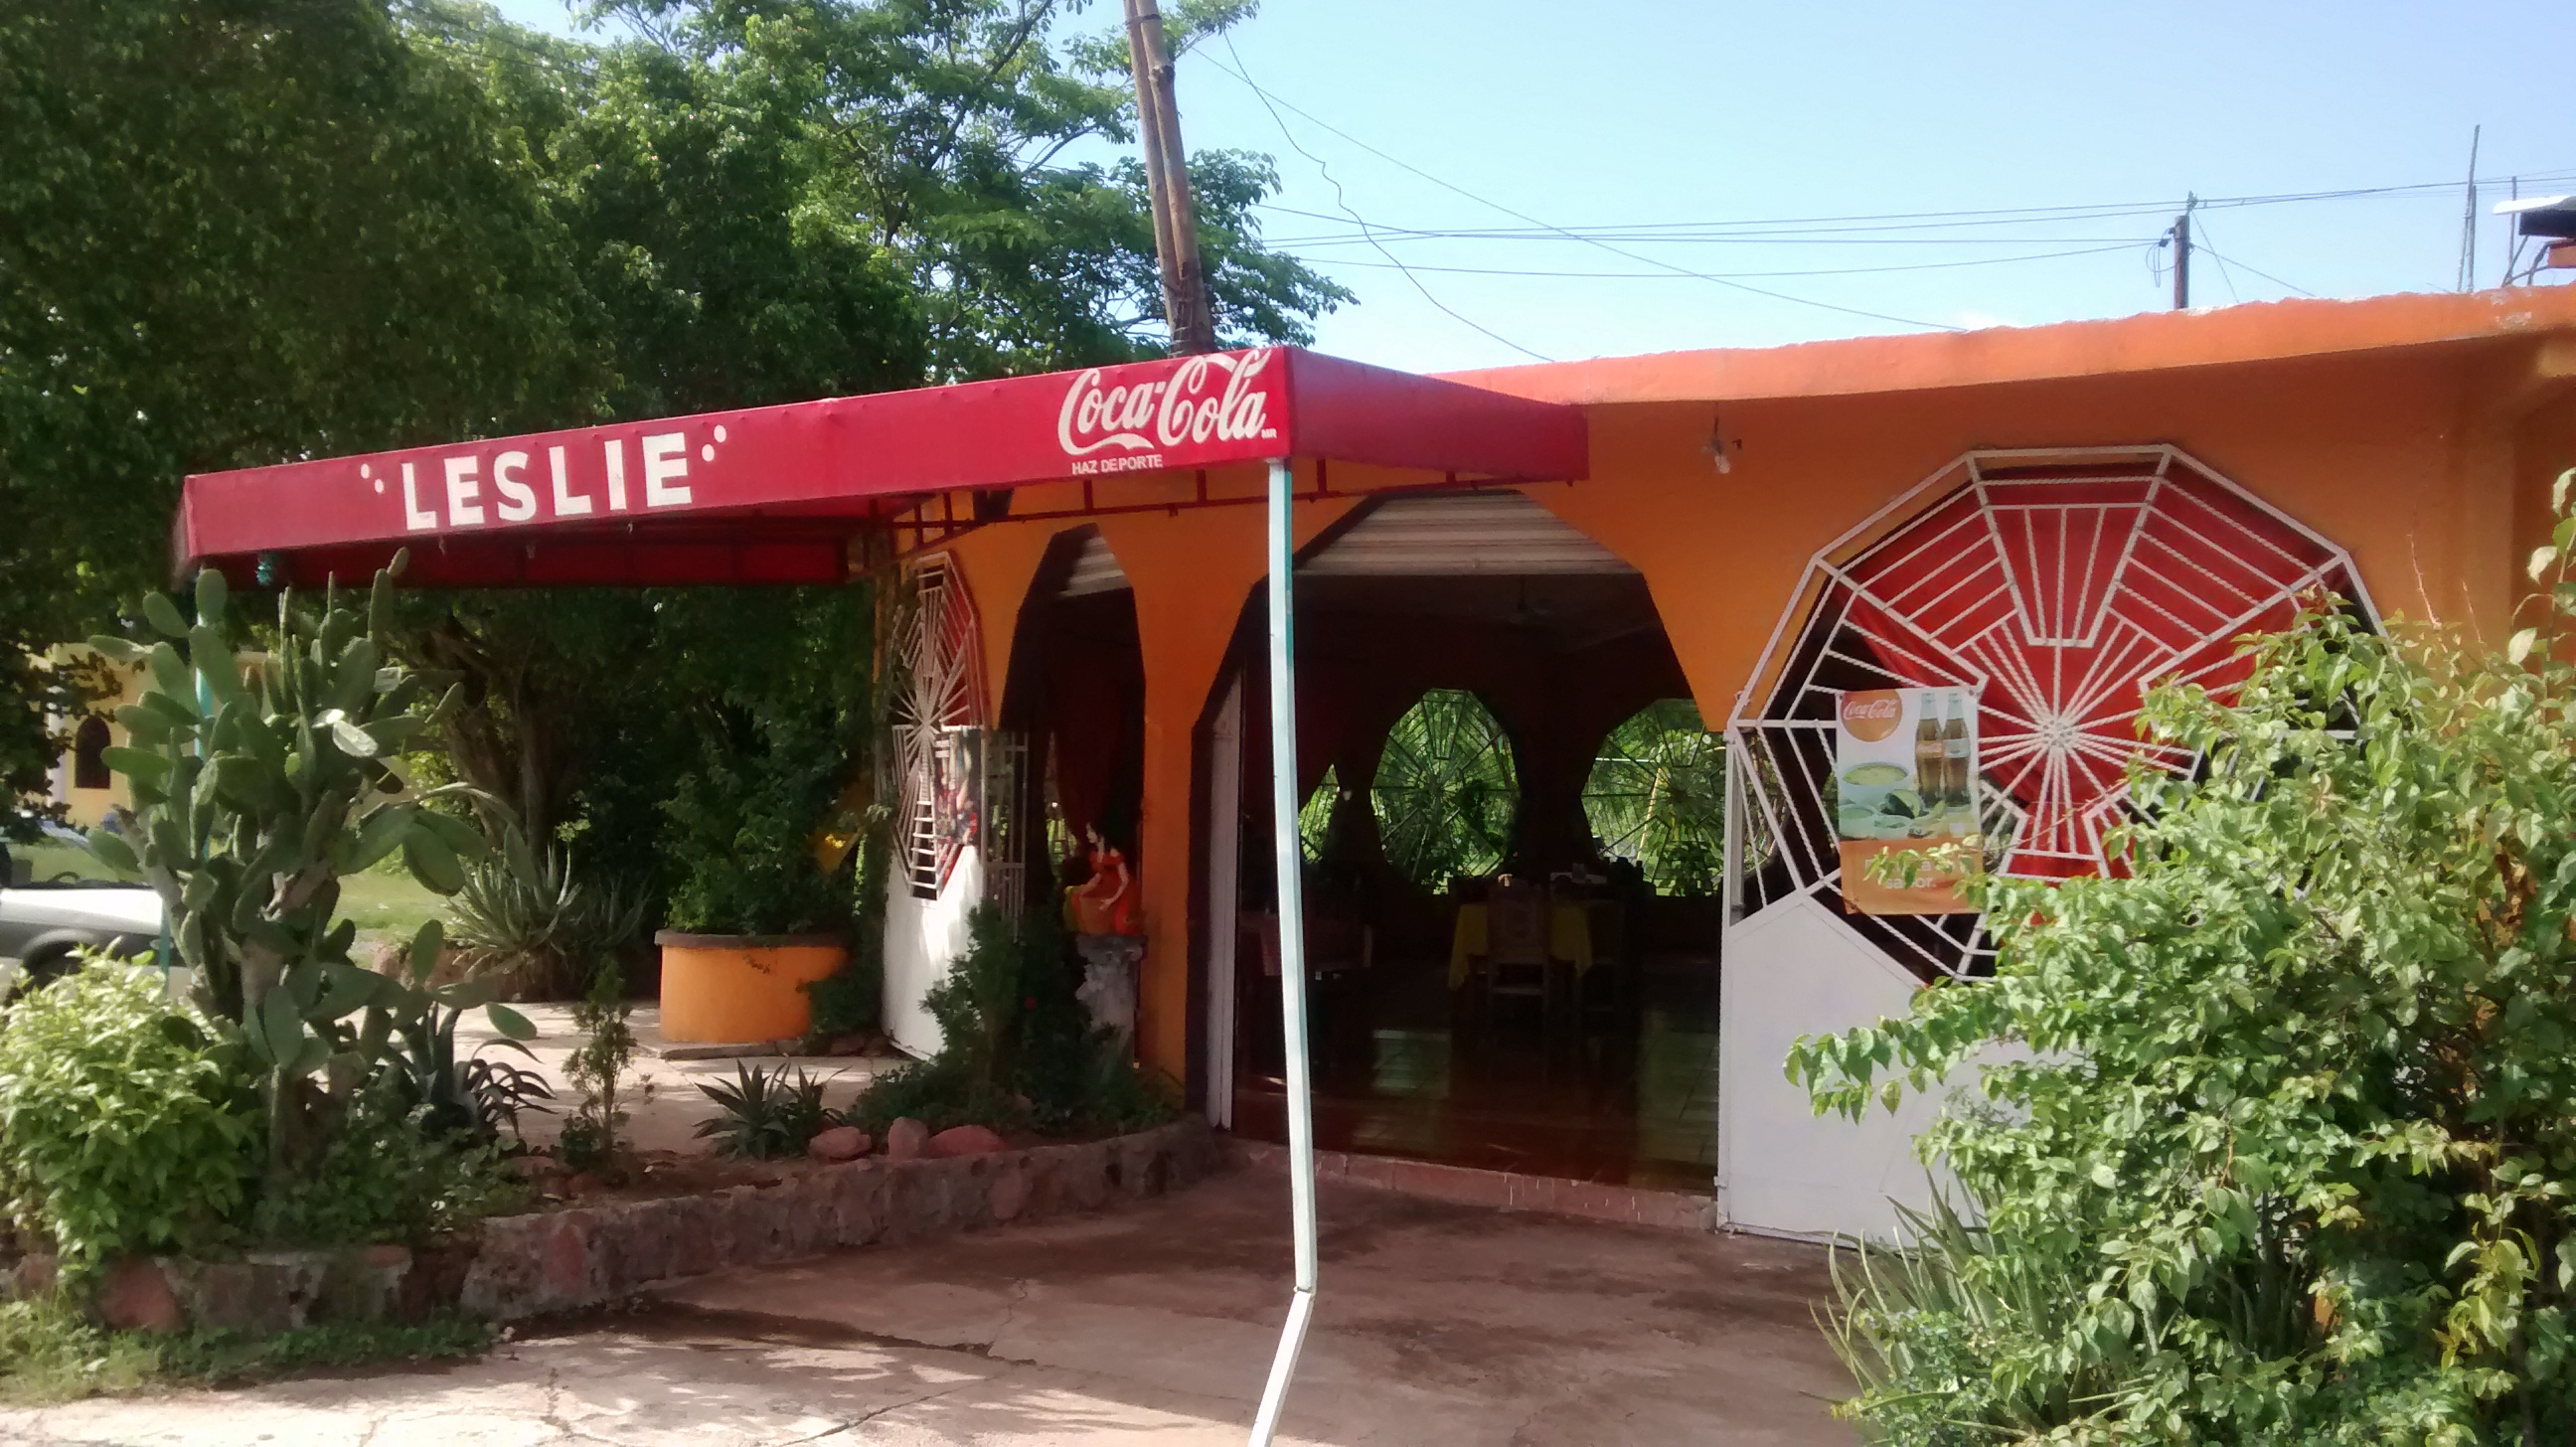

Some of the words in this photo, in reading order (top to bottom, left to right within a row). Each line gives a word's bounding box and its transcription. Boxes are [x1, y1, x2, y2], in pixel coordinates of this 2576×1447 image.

[1057, 348, 1272, 456] Coca-Cola
[1071, 461, 1099, 476] HAZ
[1100, 453, 1164, 472] DEPORTE
[402, 431, 693, 531] LESLIE
[1844, 699, 1897, 720] Coca-Cola
[1885, 877, 1937, 889] saor.
